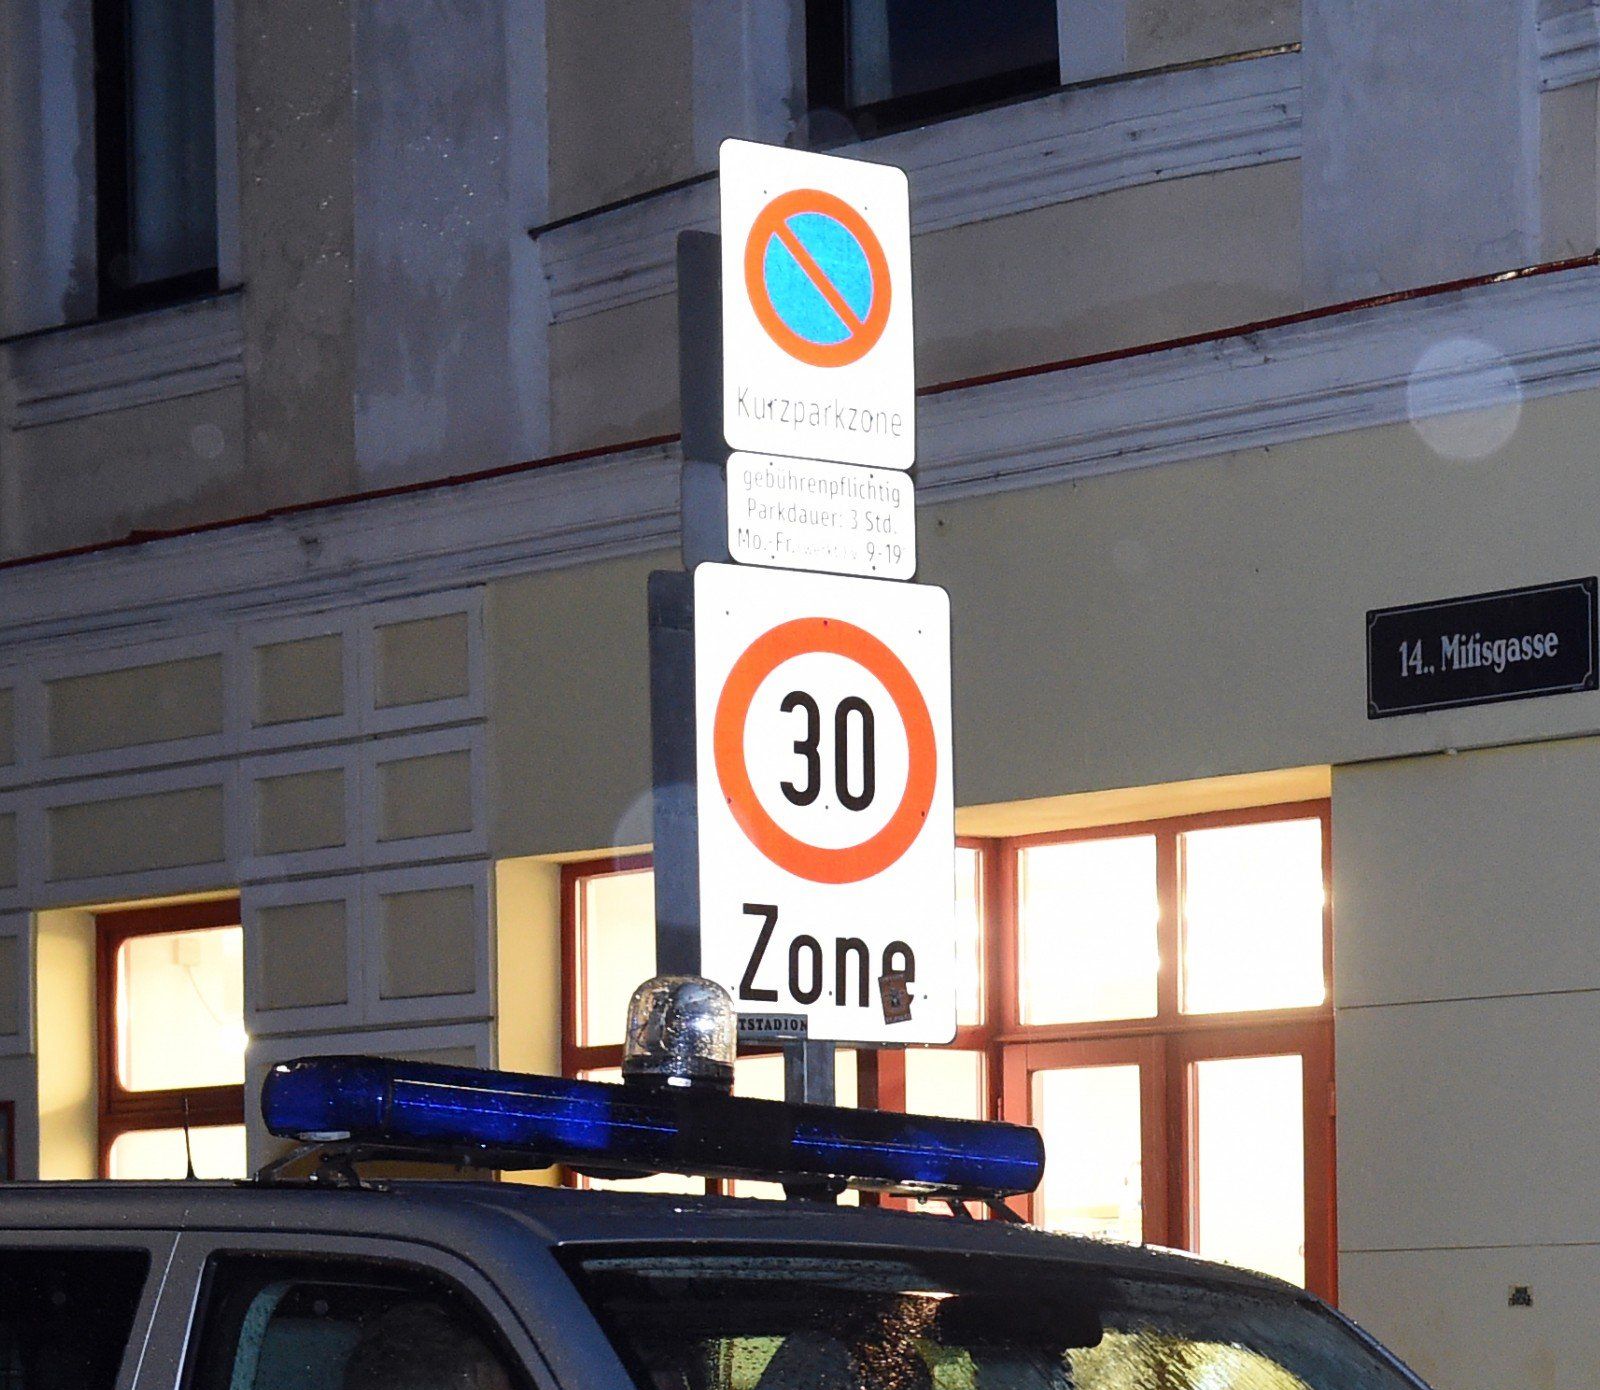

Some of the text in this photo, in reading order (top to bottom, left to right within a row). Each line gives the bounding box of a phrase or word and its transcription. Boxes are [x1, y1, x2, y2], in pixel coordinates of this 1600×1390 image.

[738, 386, 902, 437] Kurzparkzone
[743, 468, 900, 509] gebührenpflichtig
[747, 497, 897, 535] Parkdauer: 3 Std.
[1440, 632, 1559, 674] Mitisgasse
[779, 690, 876, 812] 30
[739, 903, 916, 1008] Zone
